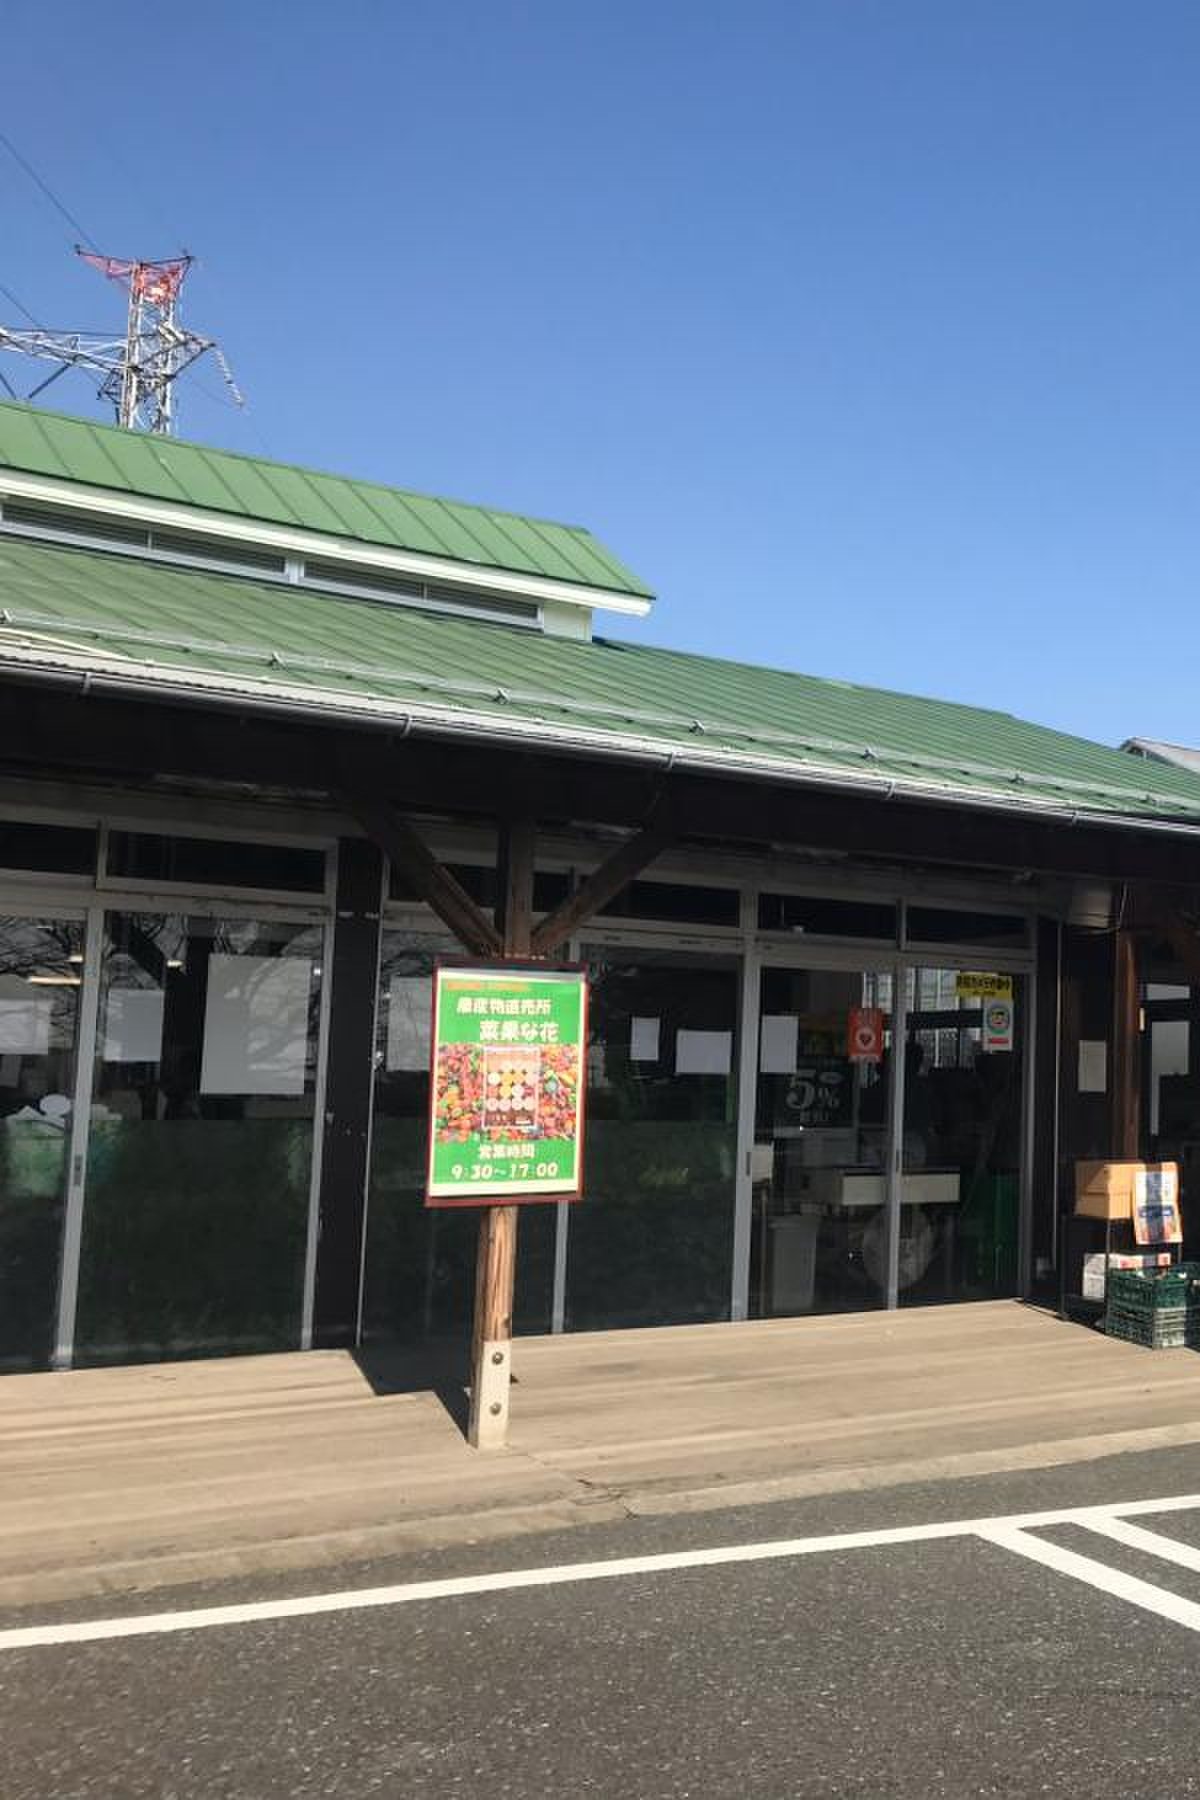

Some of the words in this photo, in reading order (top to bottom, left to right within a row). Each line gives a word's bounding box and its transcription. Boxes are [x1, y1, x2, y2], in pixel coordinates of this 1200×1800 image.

[457, 997, 552, 1015] 農産物直売所
[479, 1143, 535, 1159] 営業時間
